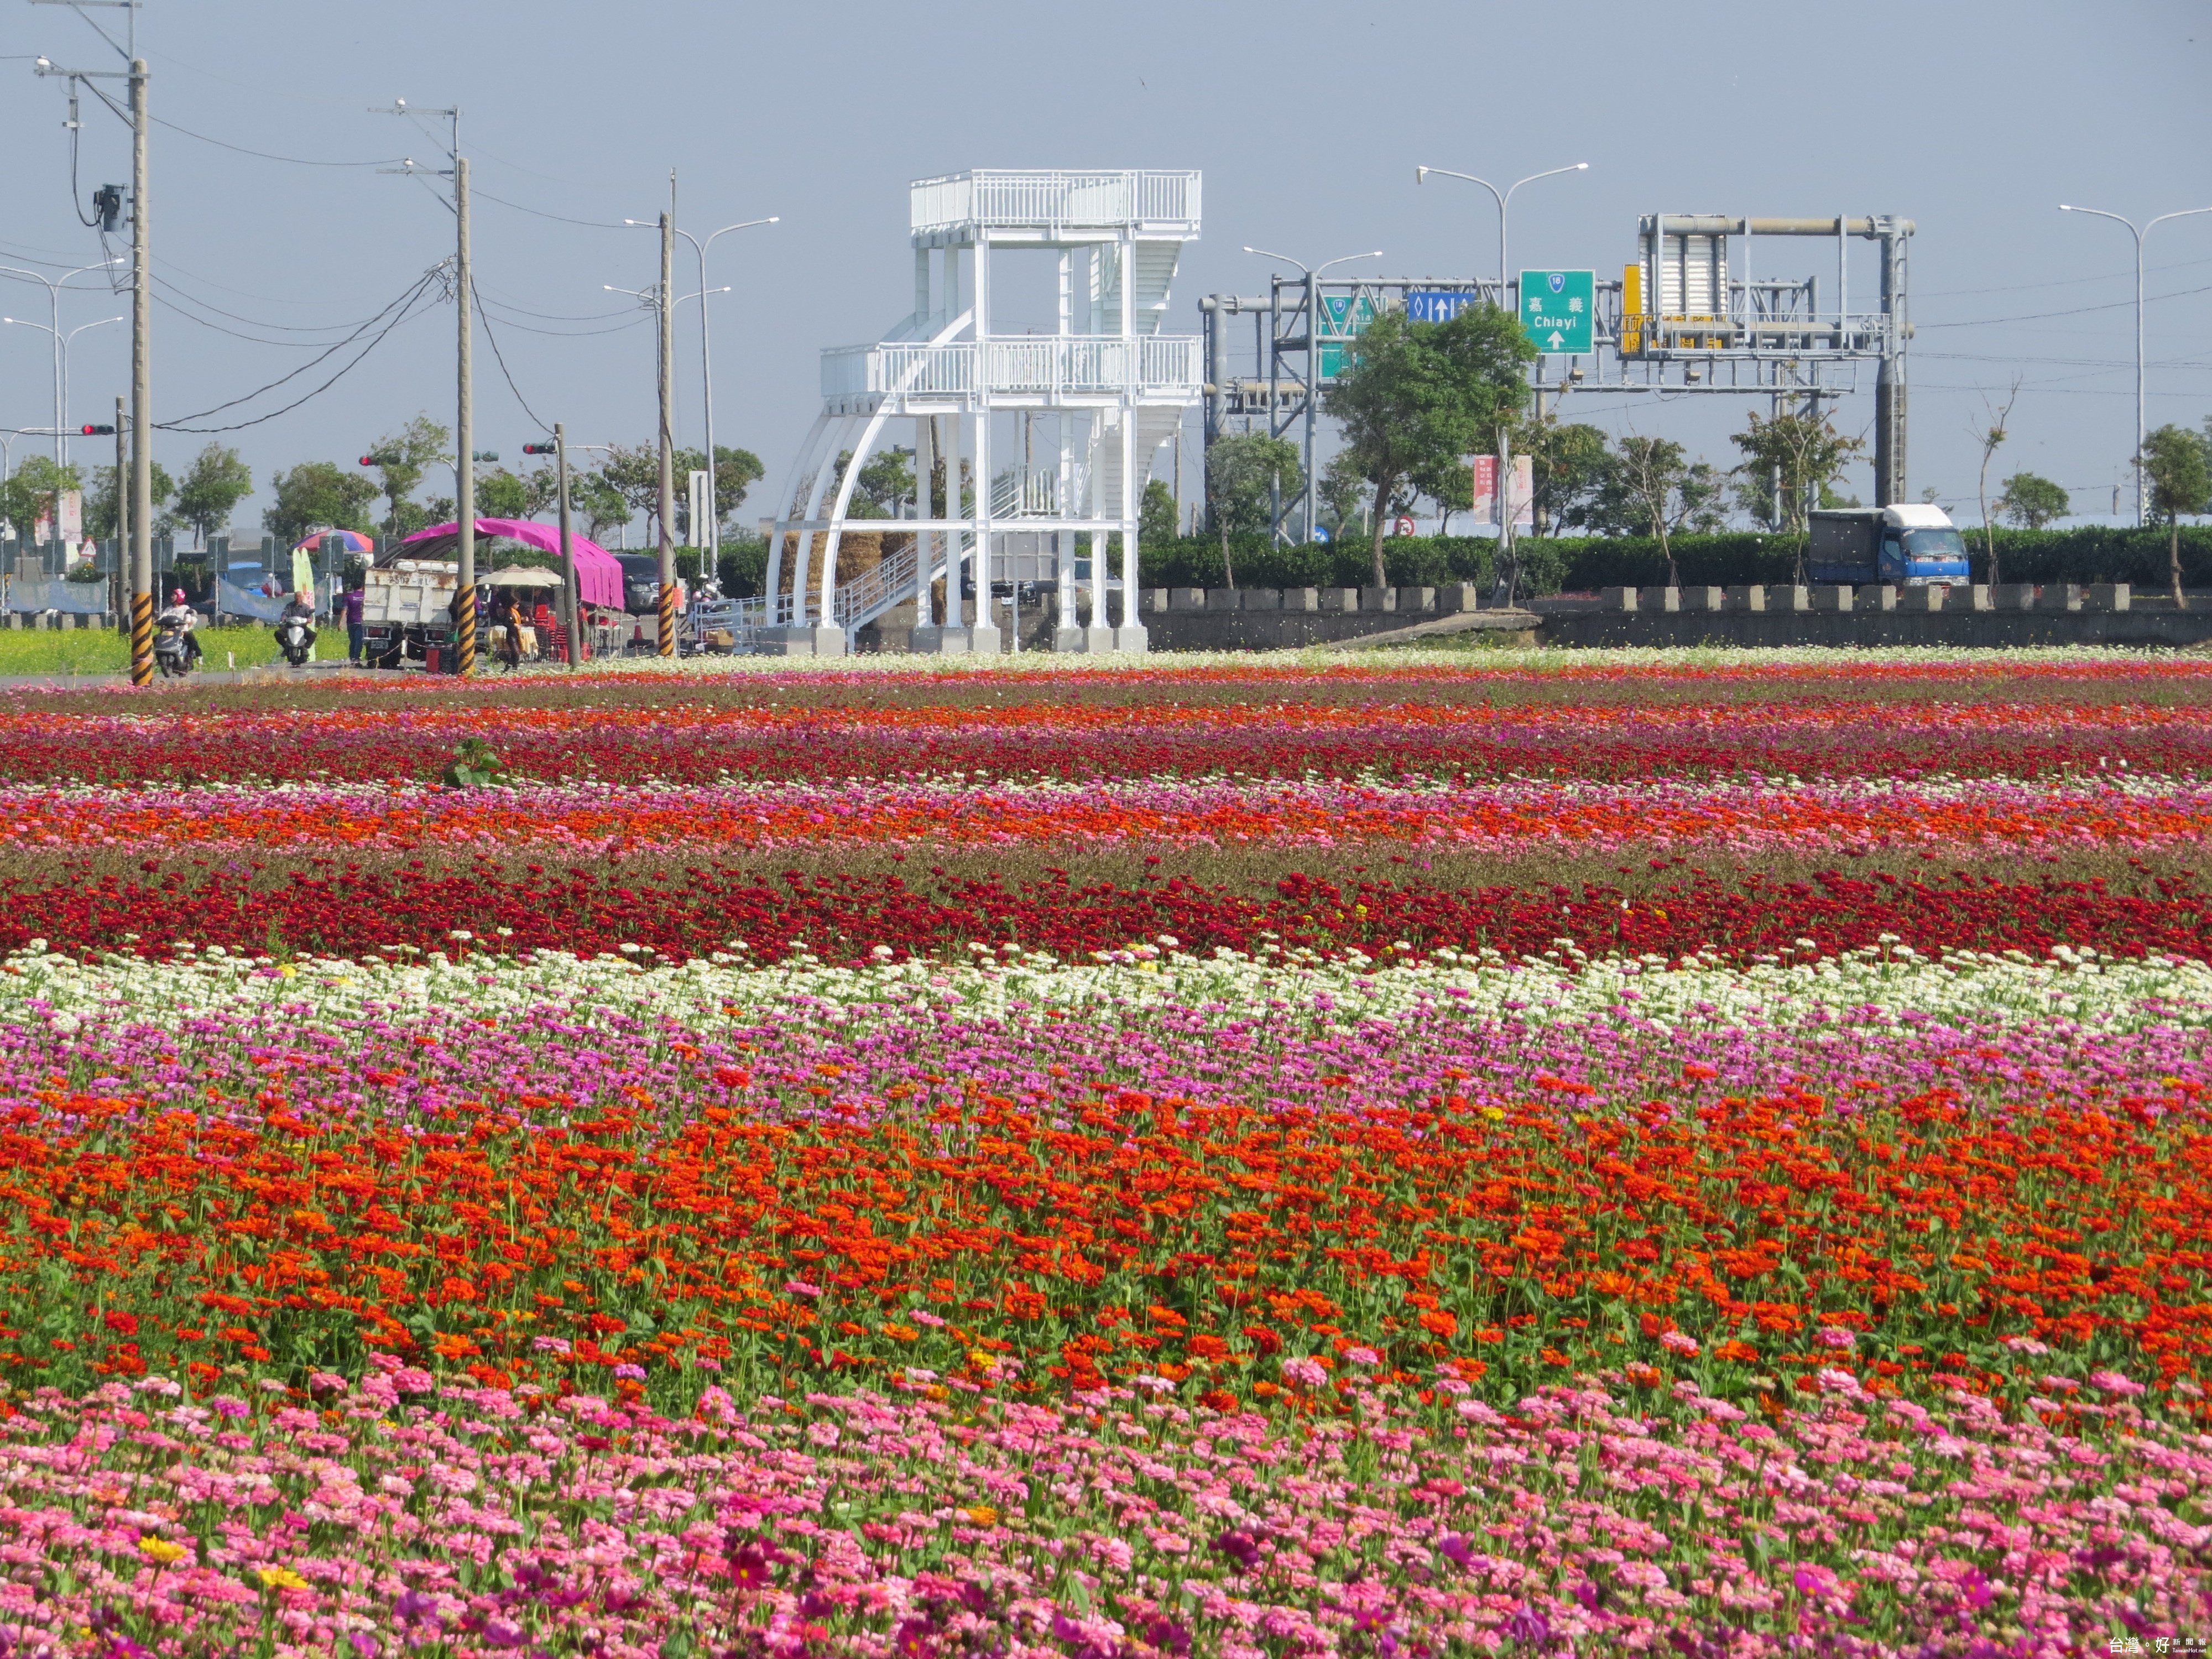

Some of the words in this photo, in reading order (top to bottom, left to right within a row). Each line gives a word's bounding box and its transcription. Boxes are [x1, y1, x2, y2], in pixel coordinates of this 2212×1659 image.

[1552, 276, 1561, 285] 18
[1528, 296, 1583, 312] 嘉義
[1534, 316, 1576, 330] Chiayi
